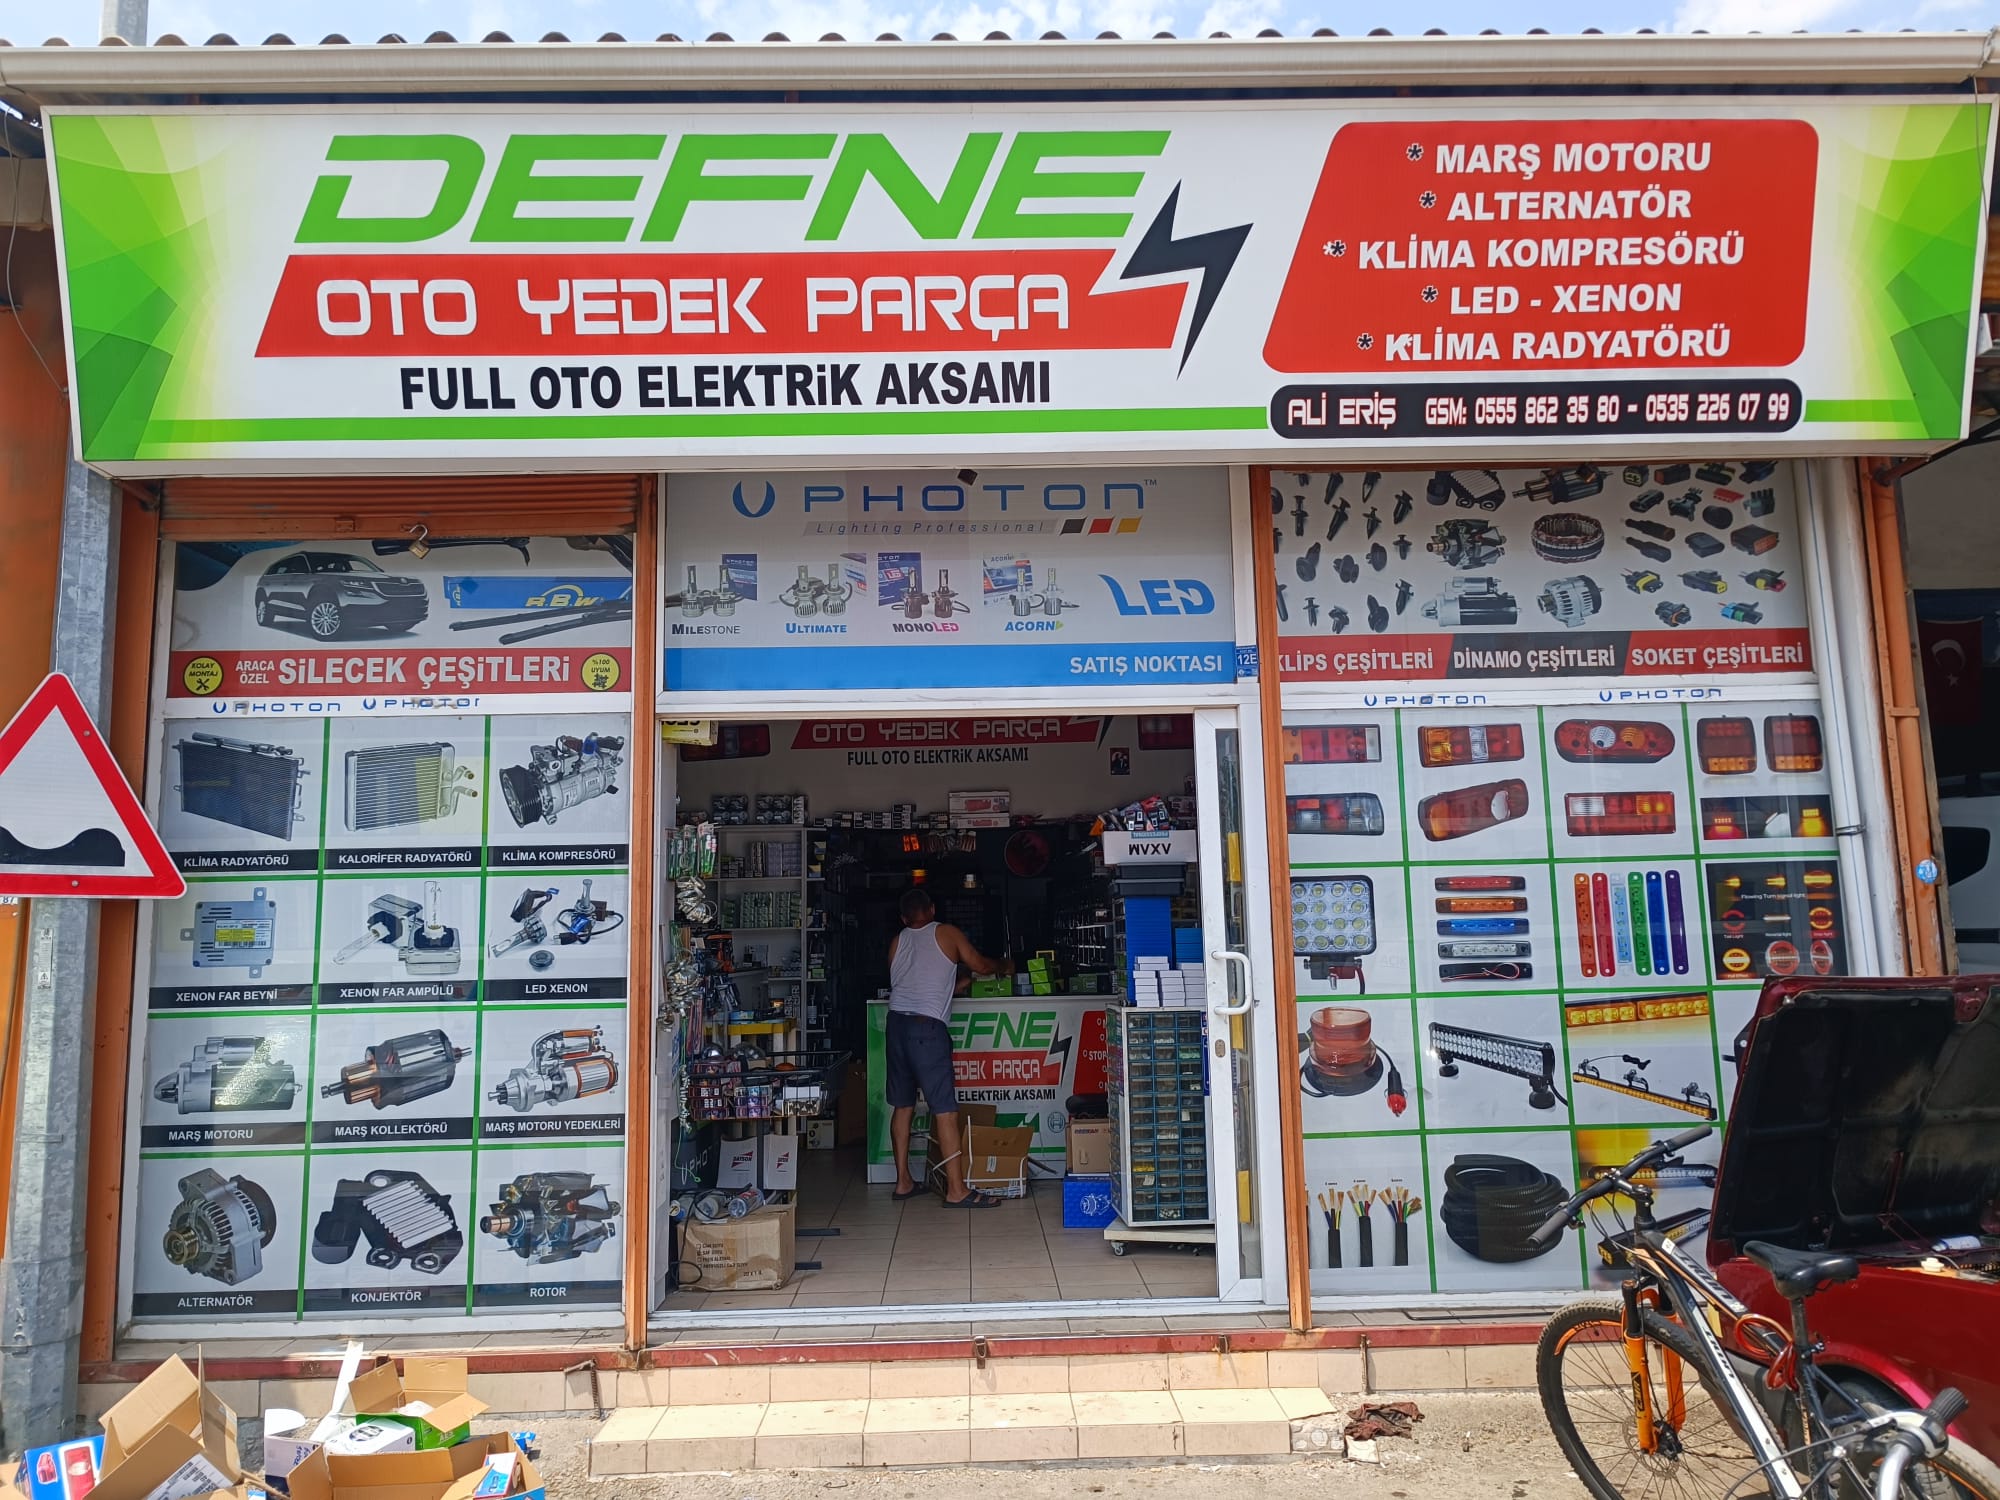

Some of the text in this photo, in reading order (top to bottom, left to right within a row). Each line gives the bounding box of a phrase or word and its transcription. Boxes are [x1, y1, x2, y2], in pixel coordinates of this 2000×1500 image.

[1436, 142, 1710, 180] MARŞ MOTORU
[294, 131, 1171, 243] DEFNE
[1447, 184, 1691, 221] ALTERNATÖR
[1359, 231, 1744, 269] KLİMA KOMPRESÖRÜ
[1450, 286, 1519, 314] LED
[1552, 283, 1681, 313] XENON
[317, 274, 1068, 341] OTO YEDEK PARÇA
[1385, 323, 1730, 362] KLİMA RADYATÖRÜ
[400, 368, 515, 410] FULL
[530, 367, 621, 409] OTO
[876, 361, 1050, 405] AKSAMI
[1287, 392, 1326, 426] ALİ
[1339, 391, 1396, 431] ERİŞ
[1425, 400, 1468, 426] GSM:
[1475, 398, 1518, 425] 0555
[1525, 397, 1559, 425] 862
[1566, 396, 1590, 424] 35
[1597, 395, 1620, 424] 80
[1645, 395, 1689, 423] 0535
[1696, 394, 1730, 422] 226
[1738, 394, 1760, 421] 07
[1768, 393, 1790, 421] 99
[804, 480, 1144, 513] PHOTON
[816, 521, 1044, 536] Lighting Professional
[1098, 574, 1216, 616] LED
[1004, 621, 1056, 632] ACORN
[1237, 653, 1258, 665] 12E
[1333, 648, 1433, 675] ÇEŞİTLERİ
[1454, 645, 1615, 673] DİNAMO ÇEŞİTLERİ
[1632, 642, 1803, 669] SOKET ÇEŞİTLERİ
[191, 662, 215, 670] KOLAY
[235, 660, 275, 672] ARACA
[1070, 656, 1128, 676] SATIŞ
[1134, 655, 1222, 673] NOKTASI
[240, 671, 270, 684] ÖZEL
[1385, 694, 1486, 705] PHOTON
[1620, 688, 1721, 700] PHOTON
[234, 702, 340, 713] PHOTON
[812, 718, 1061, 743] OTO YEDEK PARÇA
[847, 752, 878, 766] FULL
[881, 750, 910, 765] OTO
[976, 747, 1029, 762] AKSAMI
[183, 852, 289, 867] KLİMA RADYATÖRÜ
[338, 850, 472, 864] KALORİFER RADYATÖRÜ
[502, 847, 616, 861] KLİMA KOMPRESÖRÜ
[176, 988, 278, 1002] XENON FAR BEYNİ
[340, 984, 454, 998] XENON FAR AMPÜLÜ
[525, 983, 588, 995] LED XENON
[951, 1012, 1056, 1048] EFNE
[953, 1059, 1041, 1084] EDEK PARÇA
[1014, 1088, 1056, 1101] AKSAMI
[335, 1122, 448, 1139] MARŞ KOLLEKTÖRÜ
[485, 1118, 621, 1135] MARŞ MOTORU YEDEKLERİ
[168, 1129, 253, 1143] MARŞ MOTORU
[351, 1290, 422, 1303] KONJEKTÖR
[529, 1286, 567, 1298] ROTOR
[177, 1295, 253, 1308] ALTERNATÖR
